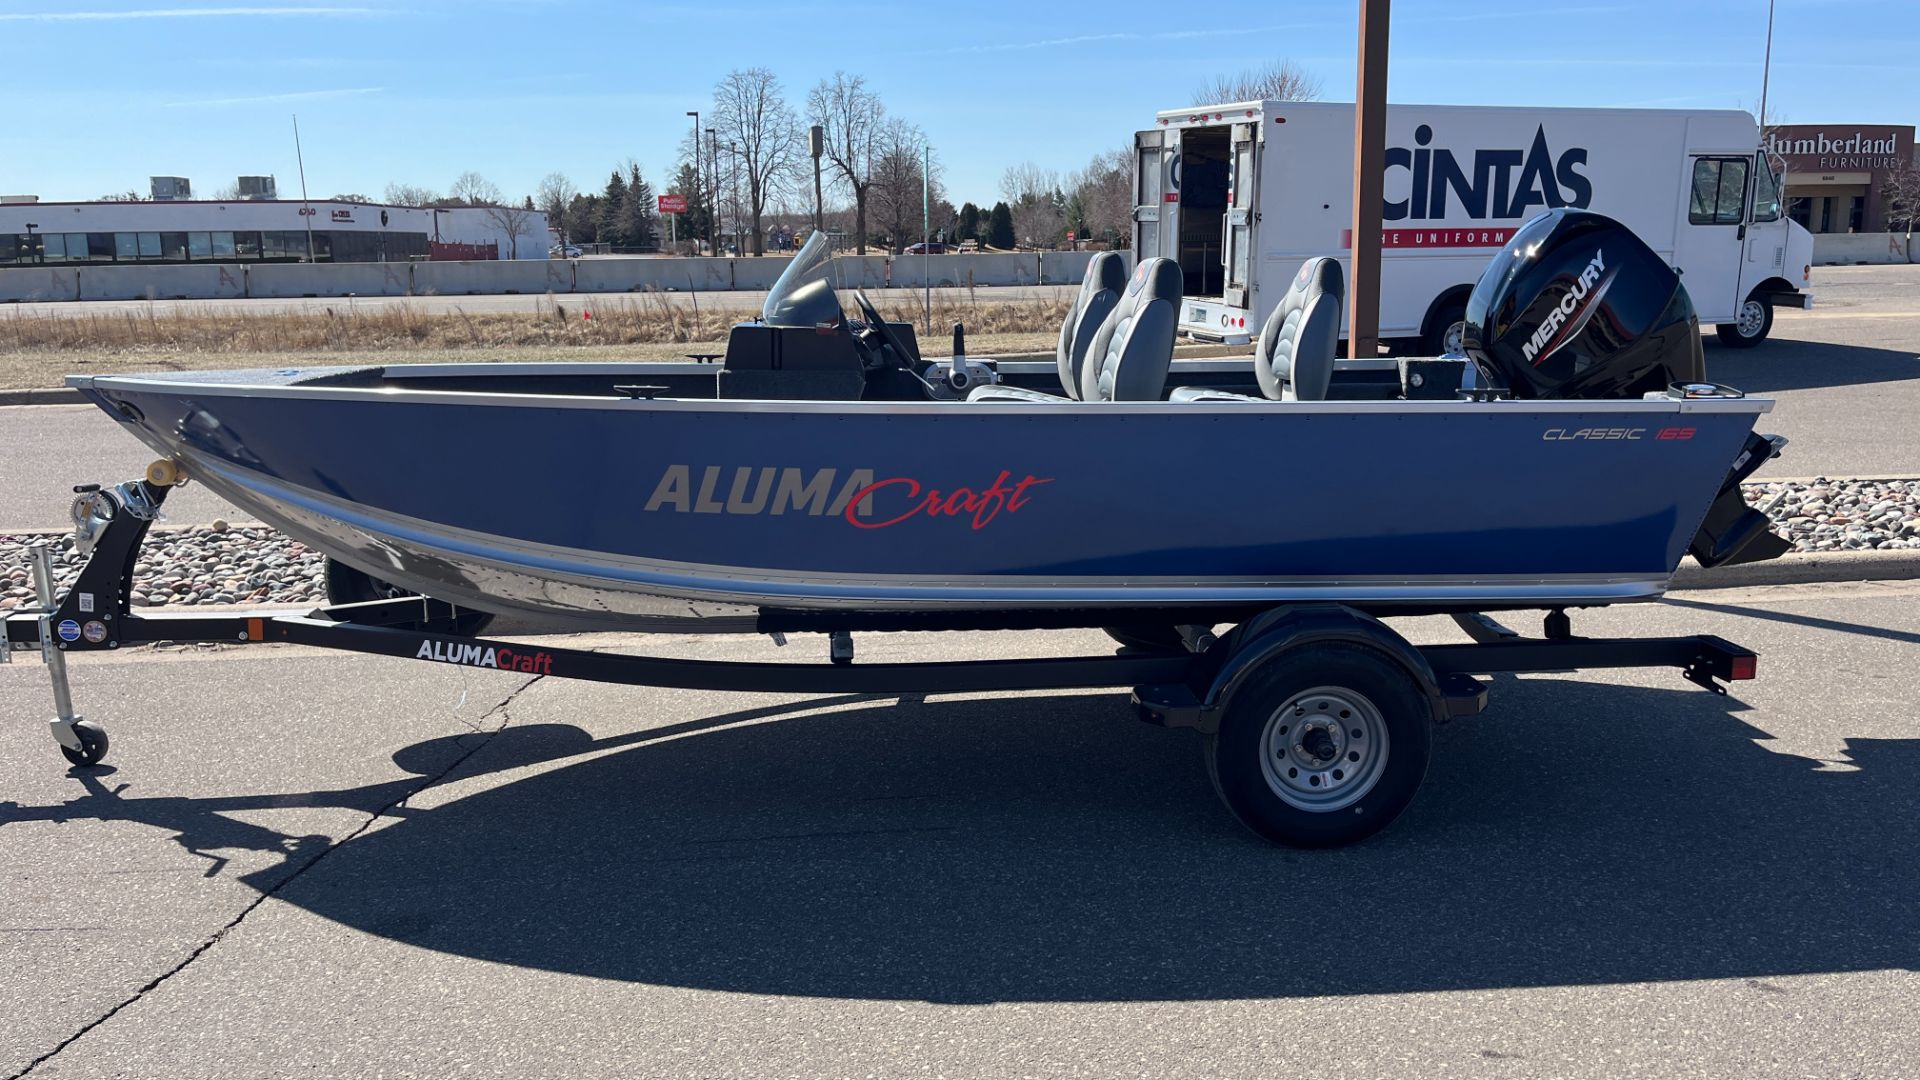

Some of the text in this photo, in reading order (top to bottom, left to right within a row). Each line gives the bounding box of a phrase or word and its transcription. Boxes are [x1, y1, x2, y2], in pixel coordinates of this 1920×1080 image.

[1767, 132, 1897, 155] lumberland
[1820, 157, 1897, 169] FURNITURE
[1415, 232, 1505, 244] UNIFORM
[1521, 247, 1606, 362] MERCURY
[1542, 427, 1697, 441] CLASSIC 165
